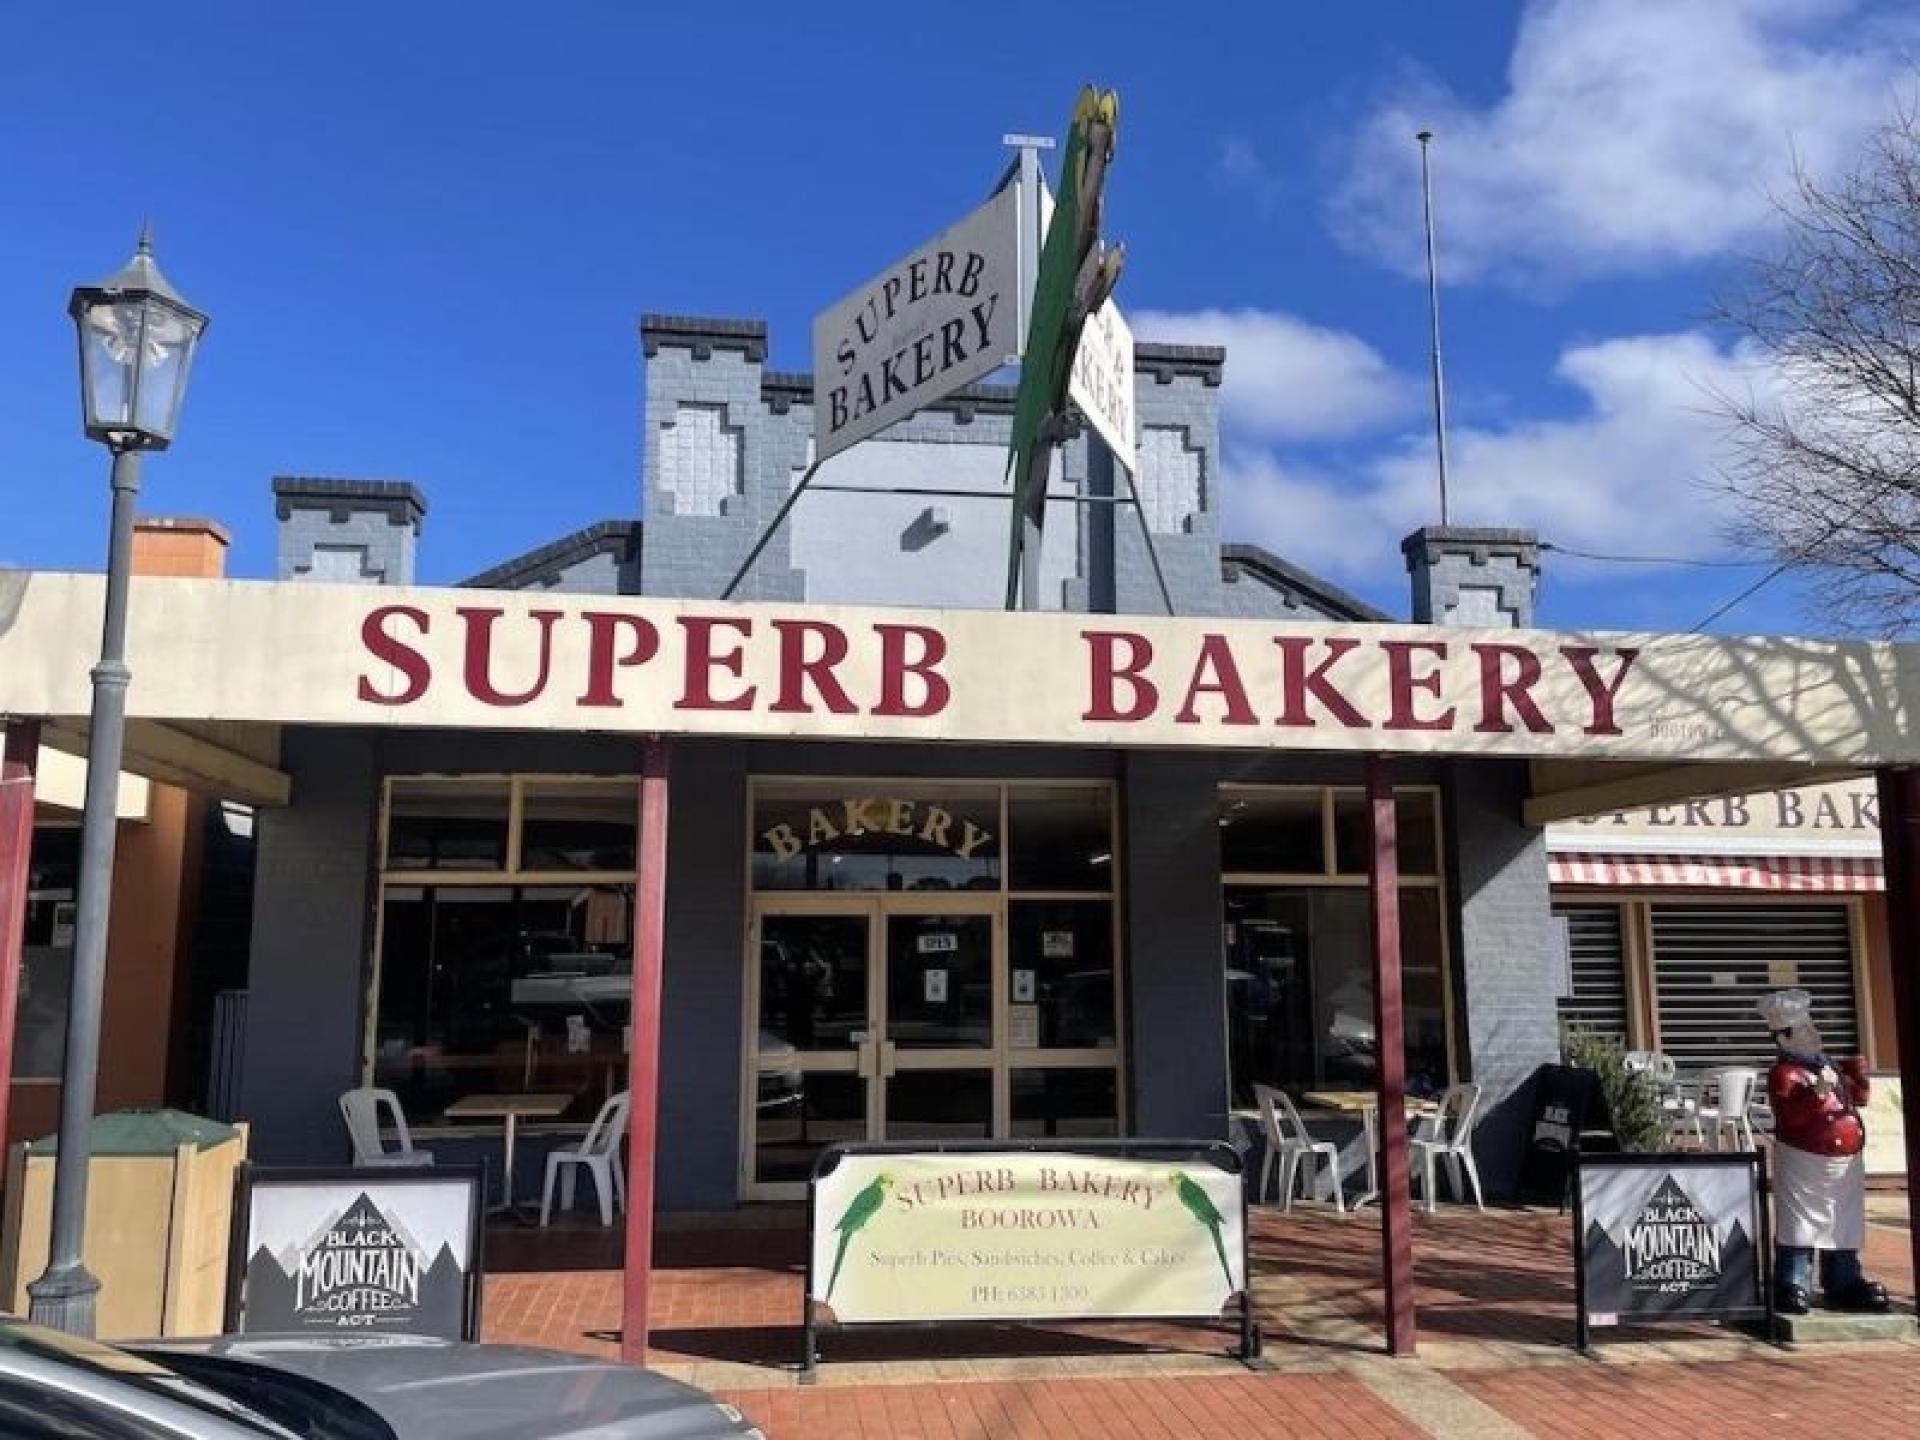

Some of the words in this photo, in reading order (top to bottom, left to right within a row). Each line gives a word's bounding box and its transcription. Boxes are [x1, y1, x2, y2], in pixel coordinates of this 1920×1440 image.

[837, 251, 985, 376] SUPERB
[829, 293, 998, 432] BAKERY
[357, 604, 952, 718] SUPERB
[1081, 630, 1641, 736] BAKERY
[763, 799, 992, 861] BAKERY
[897, 1168, 1016, 1210] SUPERB
[1039, 1168, 1163, 1210] BAKERY
[959, 1208, 1101, 1230] BOOROWA
[1645, 1206, 1700, 1223] BLACK
[328, 1230, 398, 1247] BLACK
[1624, 1222, 1721, 1280] MOUNTAIN
[294, 1248, 419, 1312] MOUNTAIN
[1651, 1258, 1700, 1280] COFFEE
[328, 1288, 392, 1311] COFFEE
[337, 1314, 376, 1326] ACT
